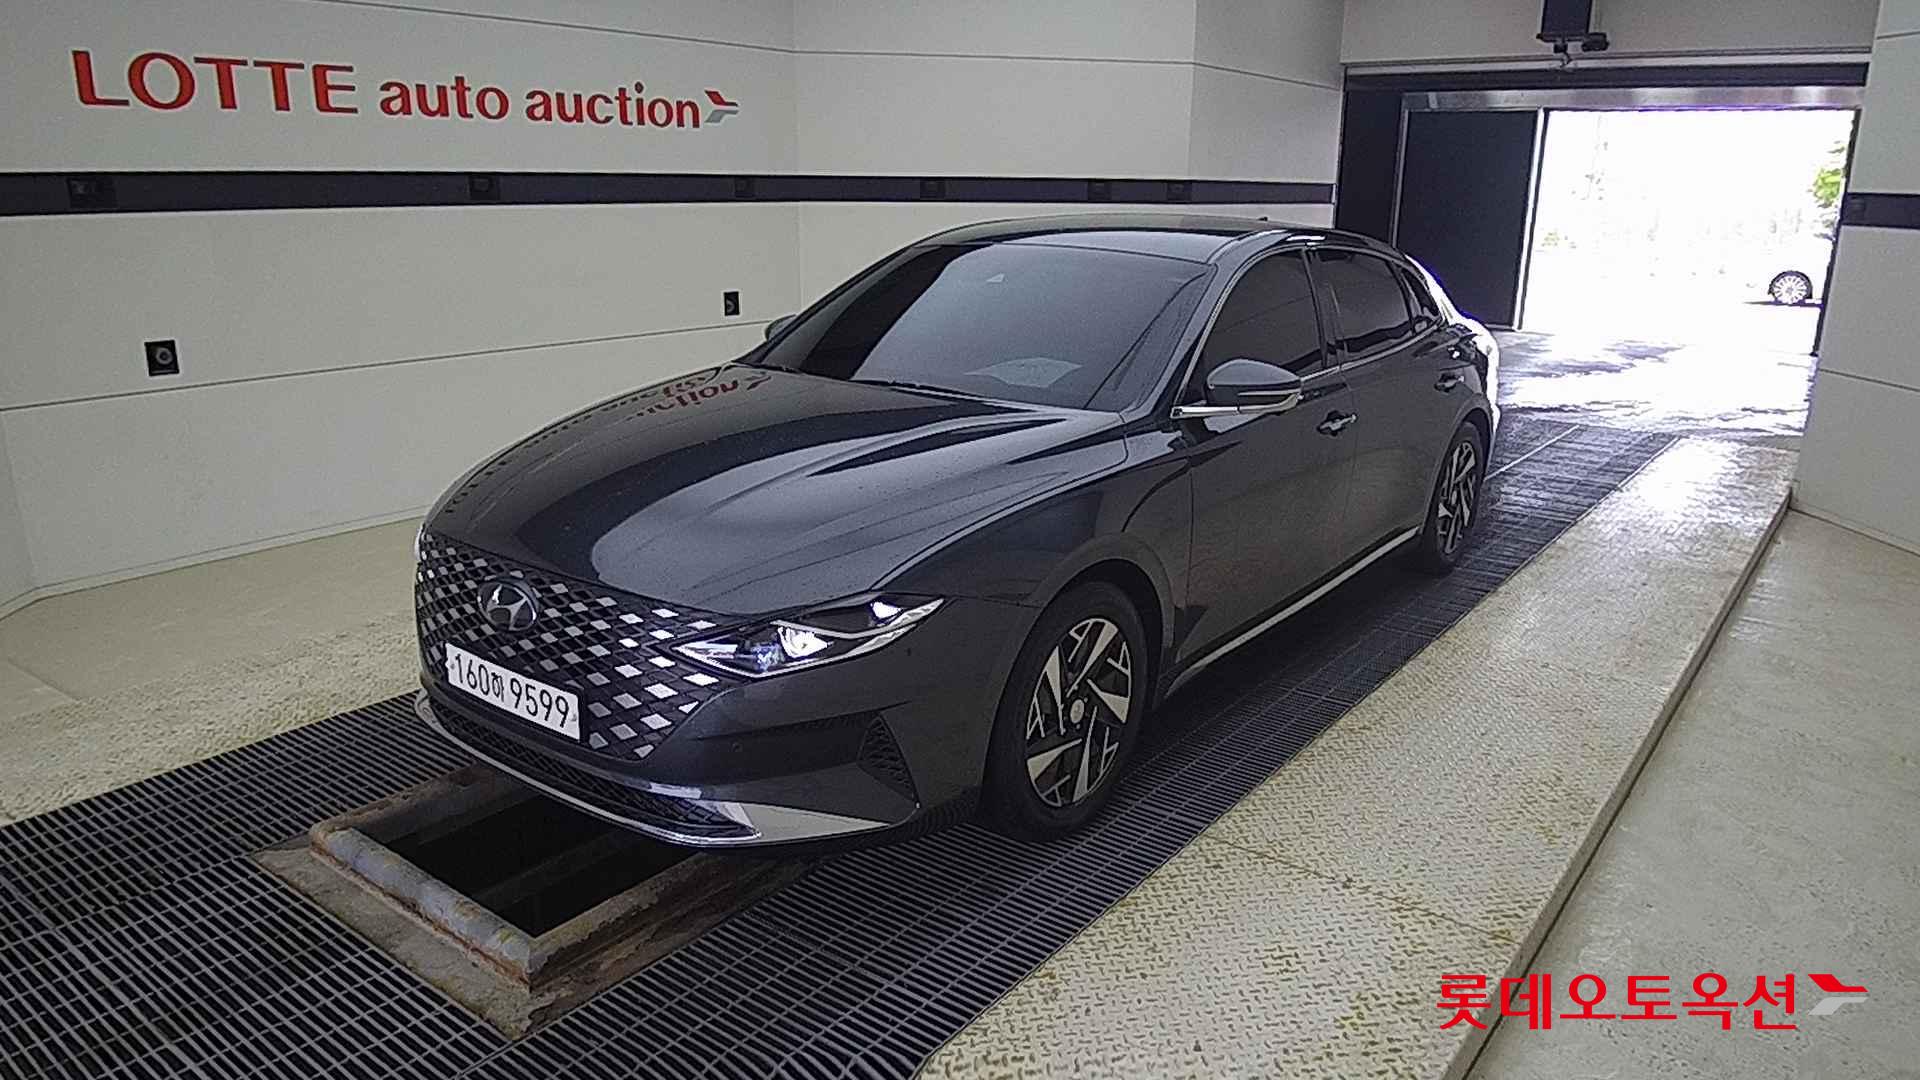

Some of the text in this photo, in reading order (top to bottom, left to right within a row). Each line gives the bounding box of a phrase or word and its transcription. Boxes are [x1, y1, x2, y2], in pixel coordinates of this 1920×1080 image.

[72, 50, 700, 128] LOTTE auto auction
[510, 677, 570, 728] 9599
